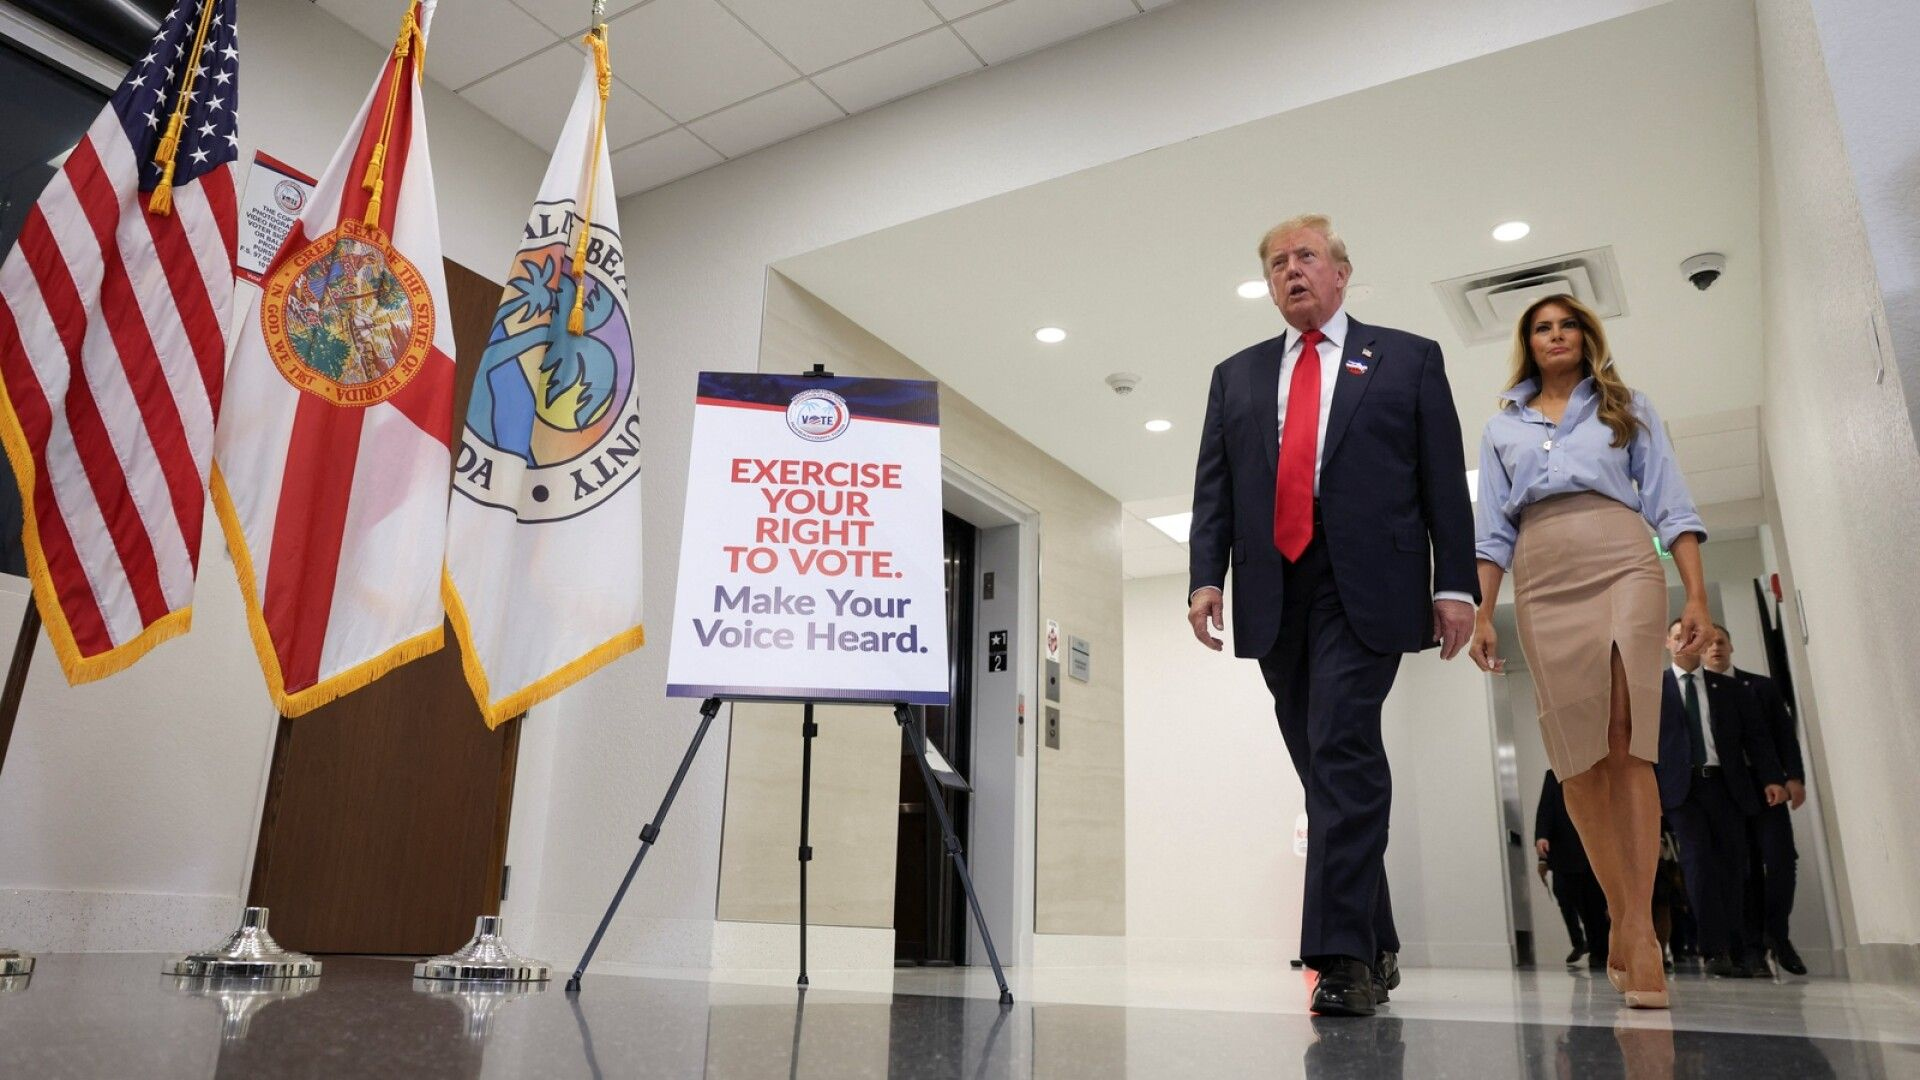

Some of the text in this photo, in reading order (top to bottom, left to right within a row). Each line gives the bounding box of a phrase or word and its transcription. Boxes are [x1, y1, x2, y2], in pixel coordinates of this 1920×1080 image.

[246, 211, 288, 235] VIDEO RECO
[252, 207, 290, 229] PHOTOGRA
[263, 205, 295, 224] THE COP
[247, 219, 284, 241] VOTER SIG
[254, 230, 280, 246] OR BAL
[253, 244, 274, 257] PURS
[294, 237, 337, 267] GREA
[271, 282, 284, 299] IN
[400, 266, 425, 297] THE
[267, 304, 280, 334] GOD
[414, 303, 430, 349] STATE
[274, 339, 290, 364] WE
[400, 354, 419, 376] OF
[336, 375, 401, 402] FLORIDA
[802, 415, 833, 425] VOTE
[731, 458, 902, 489] EXERCISE
[761, 488, 870, 517] YOUR
[755, 517, 875, 547] RIGHT
[723, 546, 903, 579] TO VOTE.
[713, 585, 911, 619] Make Your
[692, 618, 928, 654] Voice Heard.
[994, 655, 1001, 671] 2
